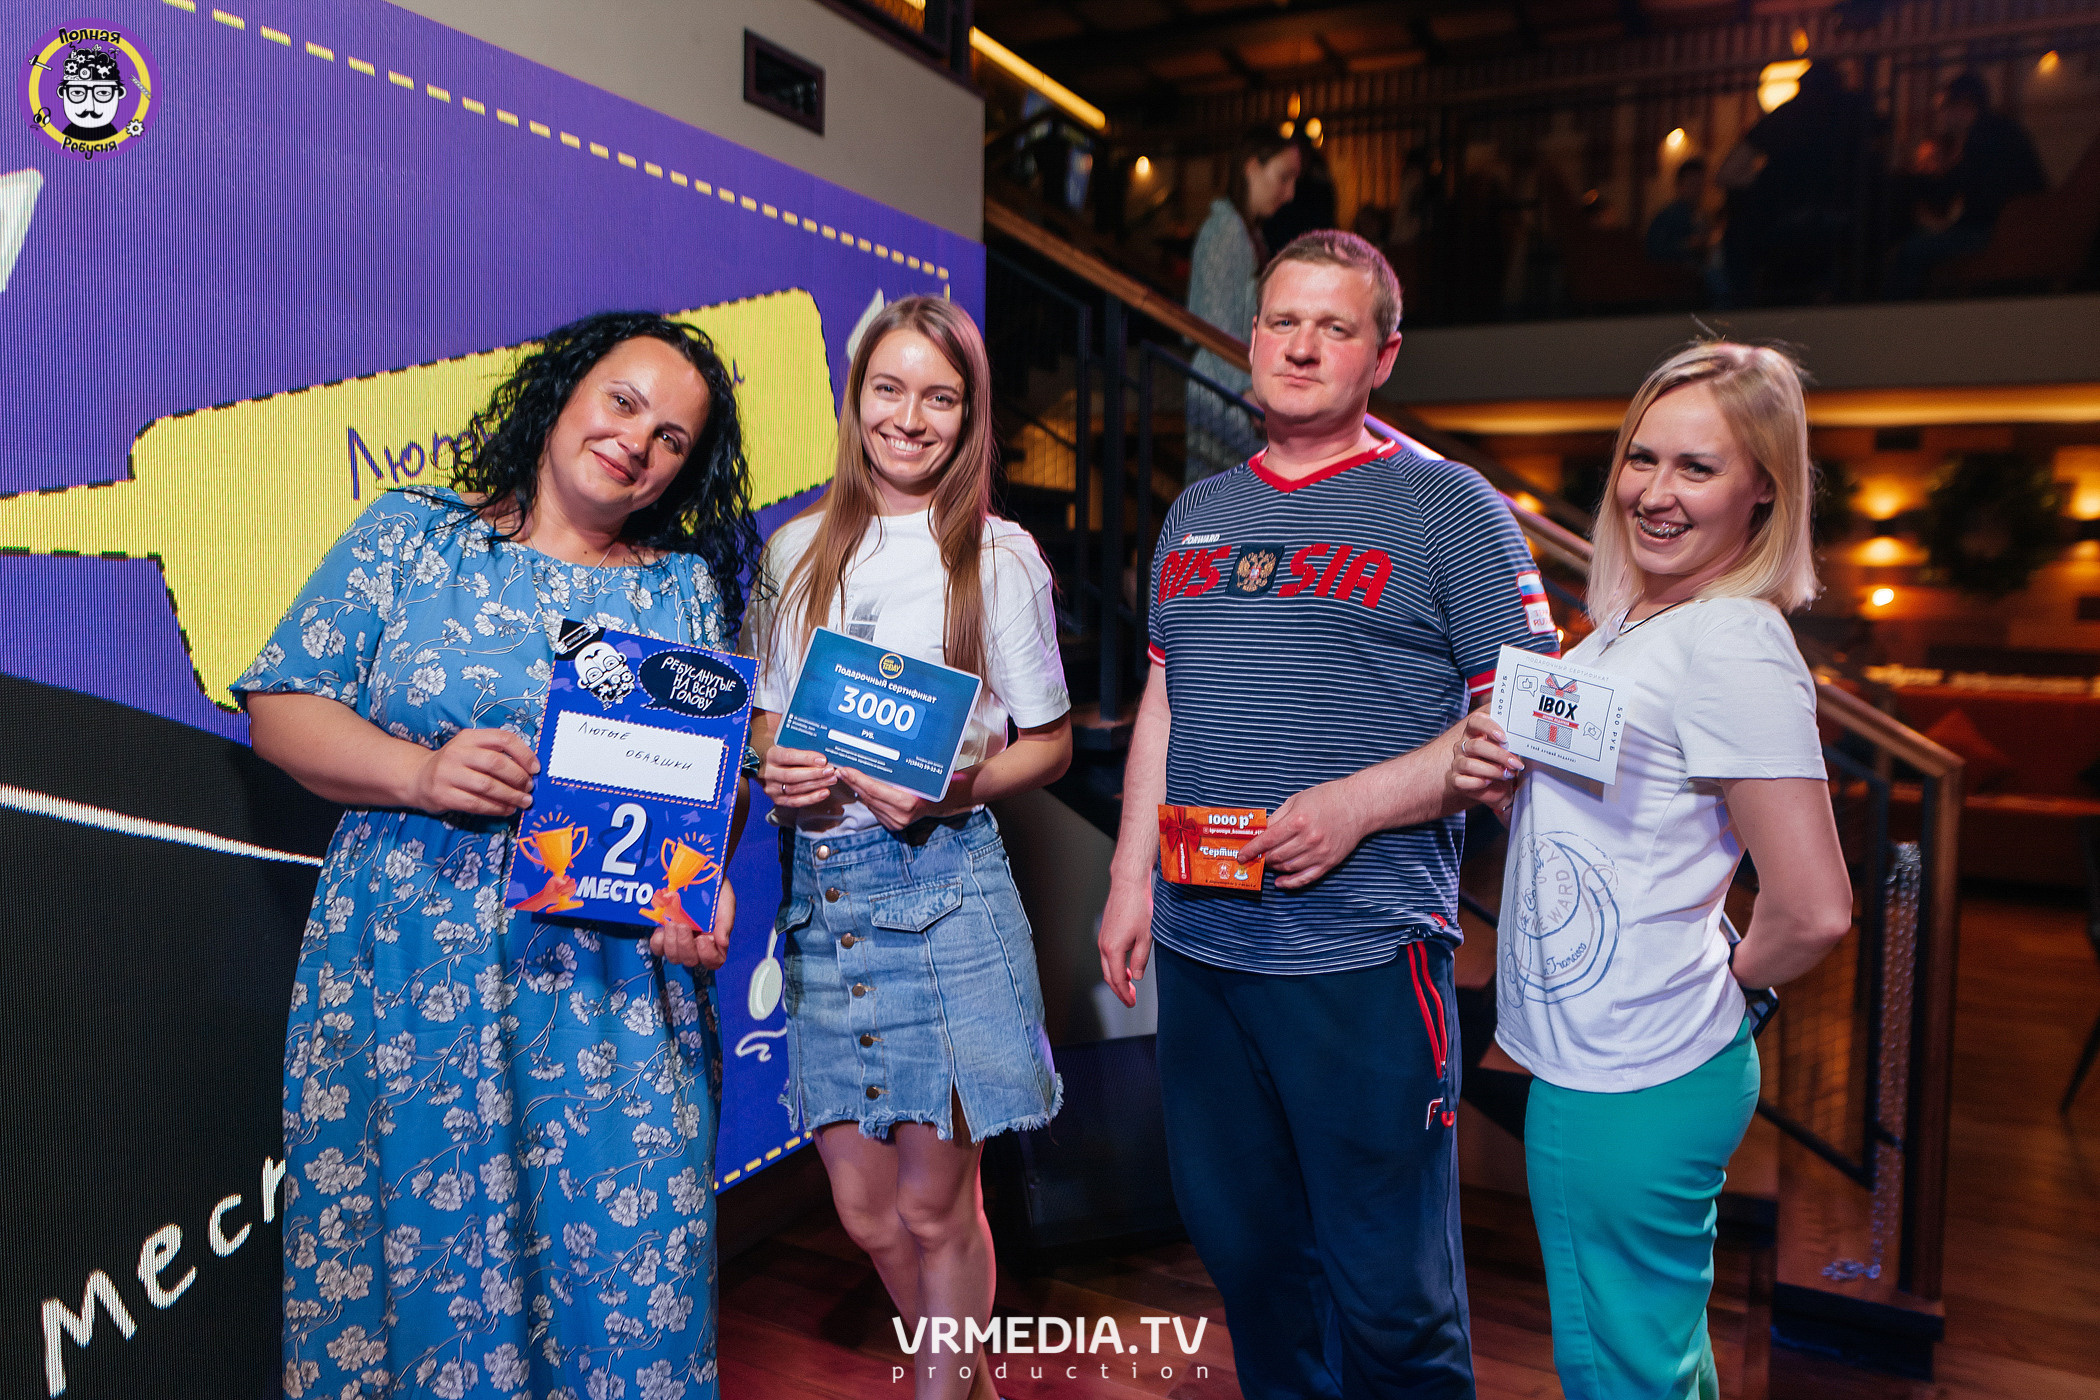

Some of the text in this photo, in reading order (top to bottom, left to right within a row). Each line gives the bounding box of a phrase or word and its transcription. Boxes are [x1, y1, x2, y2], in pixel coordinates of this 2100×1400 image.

[834, 663, 938, 705] Подарочный сертификат
[837, 685, 916, 732] 3000
[1538, 694, 1579, 721] IBOX
[1208, 814, 1237, 826] 1000
[602, 803, 647, 876] 2
[575, 876, 654, 906] МЕСТО
